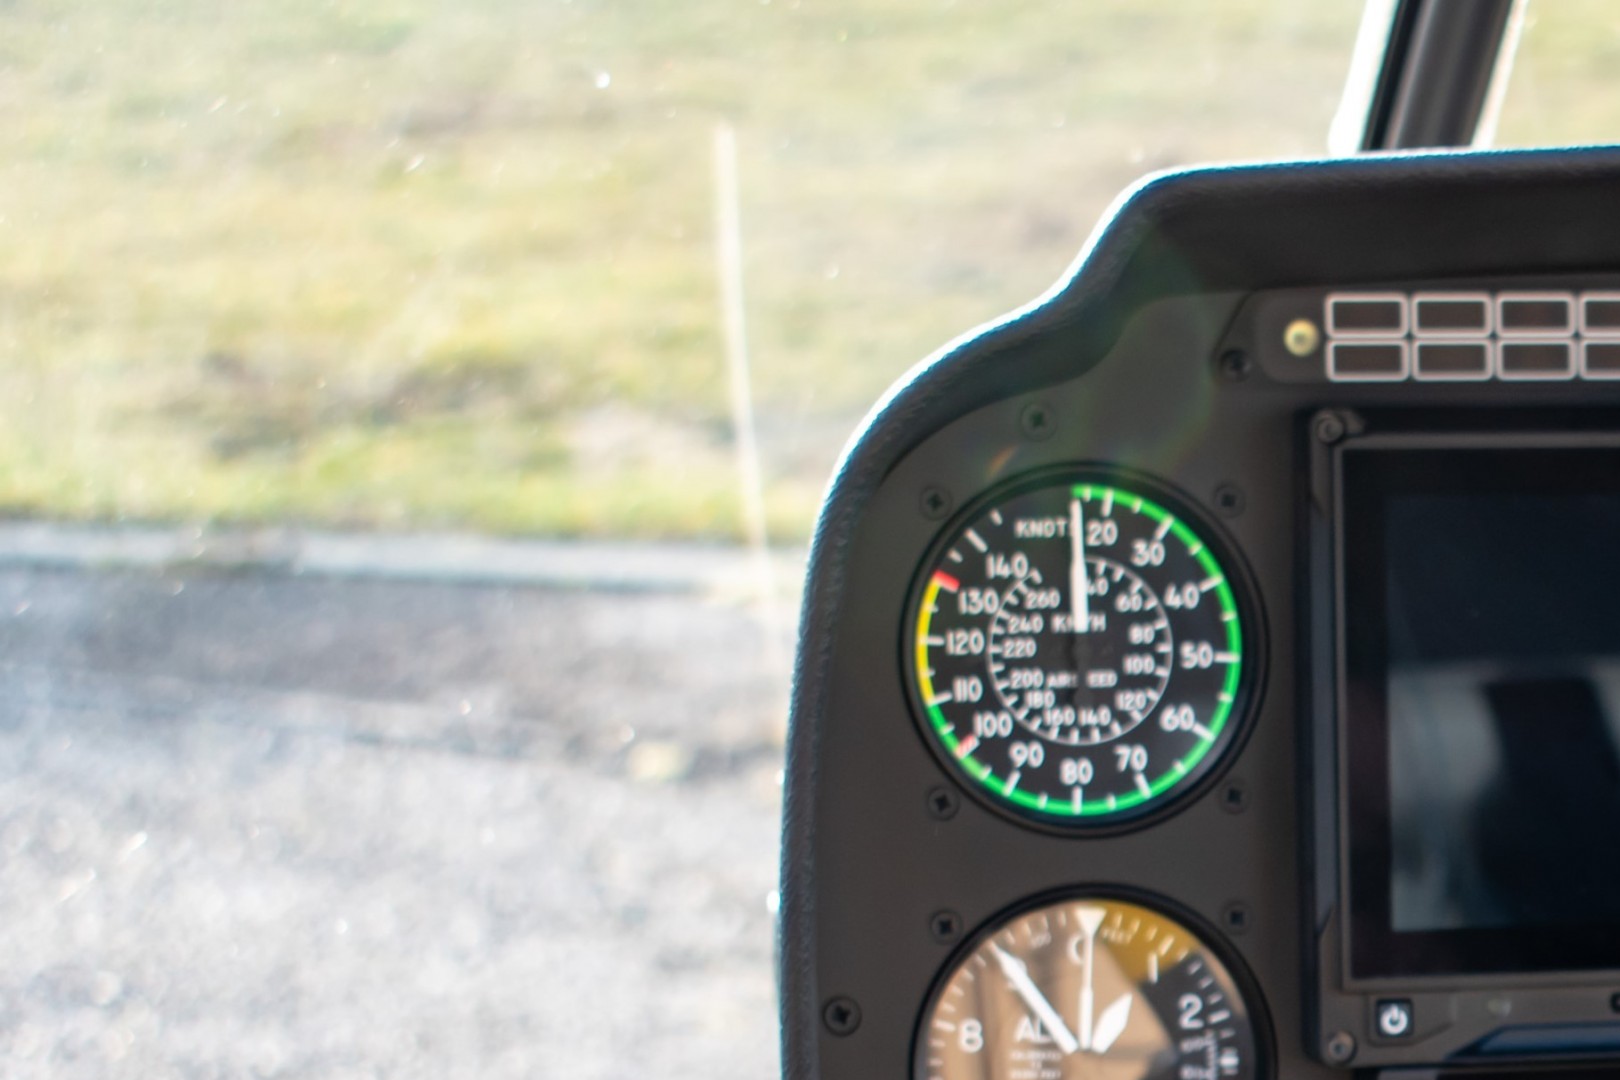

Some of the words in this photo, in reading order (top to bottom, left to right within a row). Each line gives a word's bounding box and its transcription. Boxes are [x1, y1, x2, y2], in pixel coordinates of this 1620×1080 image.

[1014, 518, 1072, 538] KNOT
[1087, 520, 1118, 546] 20
[985, 552, 1029, 580] 140
[1131, 540, 1166, 567] 30
[958, 588, 1000, 616] 130
[1115, 593, 1143, 613] 60
[1164, 585, 1200, 609] 40
[946, 629, 985, 656] 120
[1180, 642, 1213, 669] 50
[1122, 654, 1156, 677] 100
[952, 676, 983, 703] 110
[1009, 669, 1045, 690] 200
[1115, 688, 1147, 712] 120
[973, 710, 1013, 739] 100
[1159, 704, 1196, 733] 60
[1009, 741, 1045, 769] 90
[1114, 744, 1149, 772] 70
[1059, 758, 1094, 787] 80
[1178, 993, 1204, 1030] 2
[959, 1017, 983, 1052] 8
